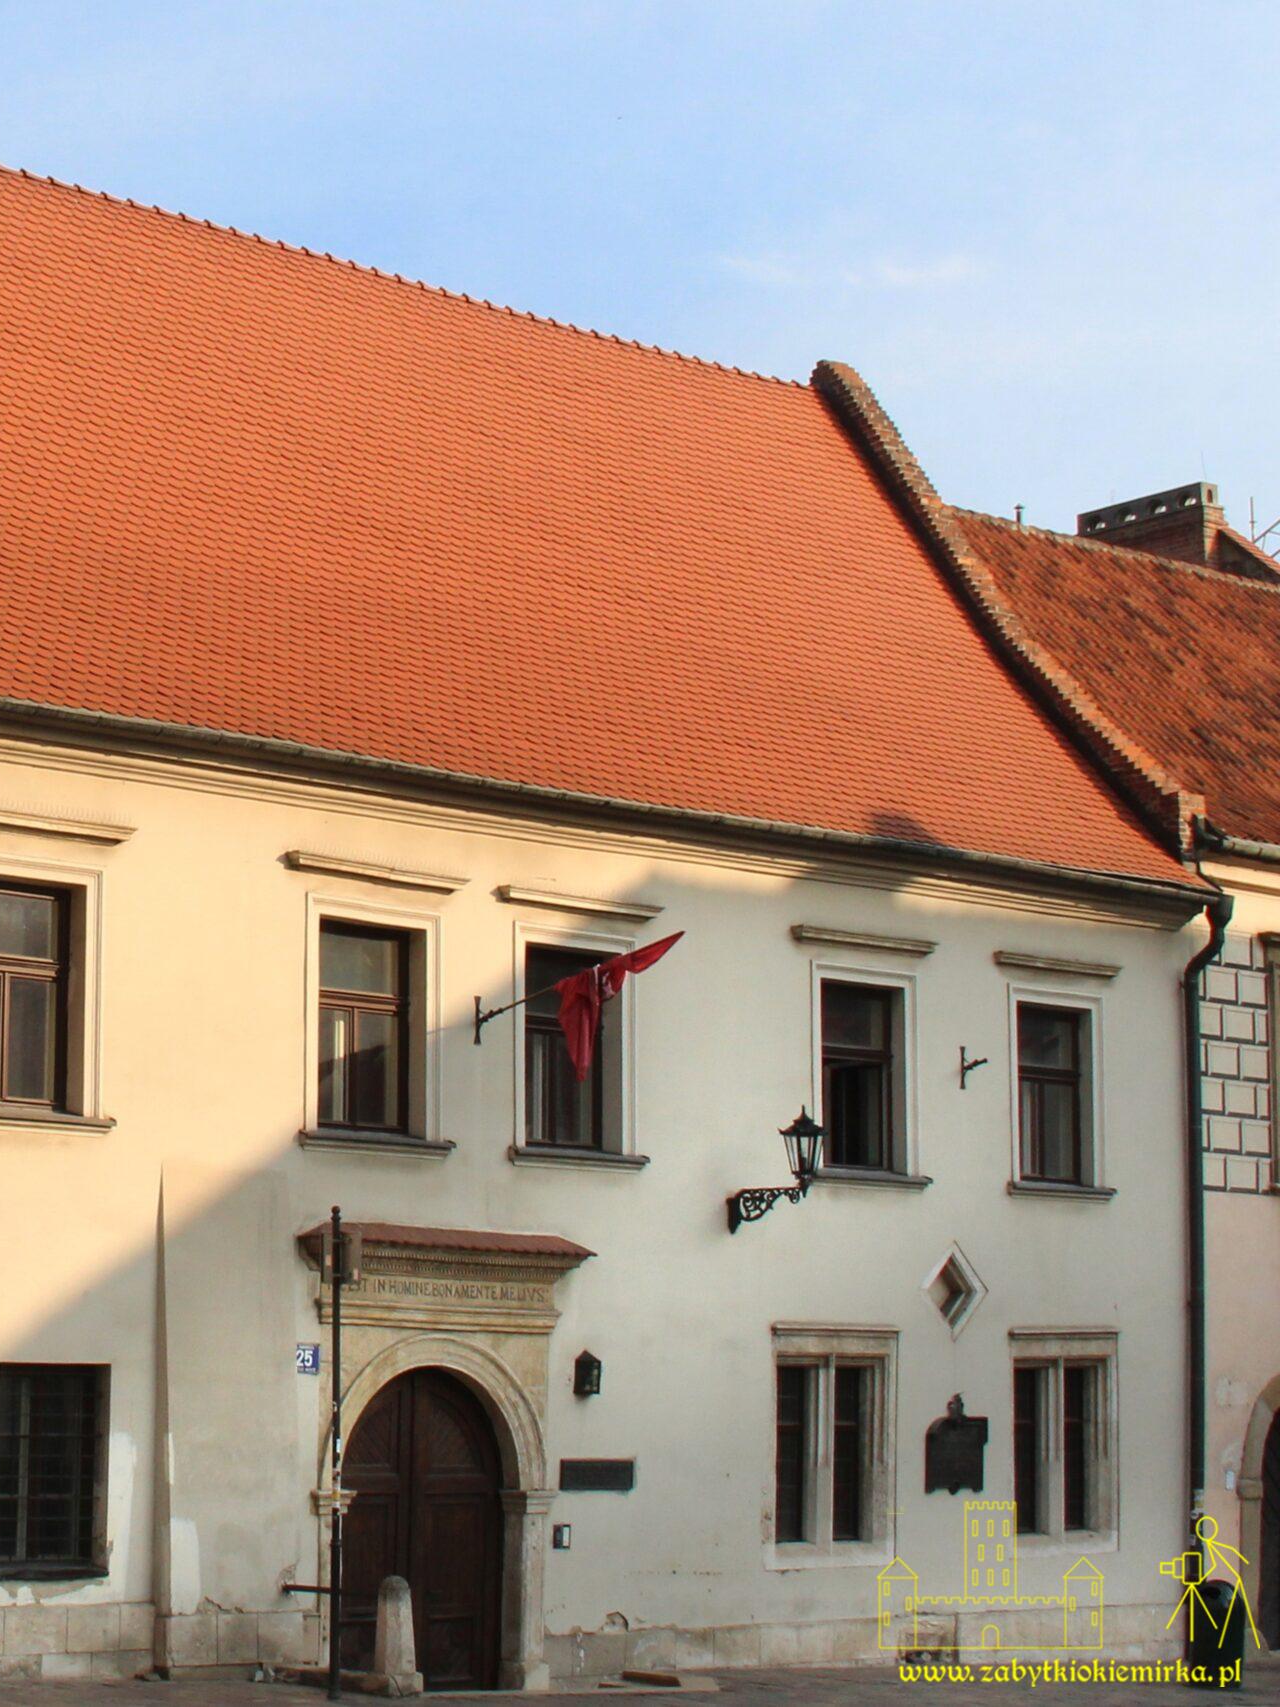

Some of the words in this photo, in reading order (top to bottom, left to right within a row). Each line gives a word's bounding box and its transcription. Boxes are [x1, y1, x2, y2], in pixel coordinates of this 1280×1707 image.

[374, 1279, 385, 1293] IN
[389, 1280, 431, 1296] HOMINE
[296, 1349, 313, 1367] 25
